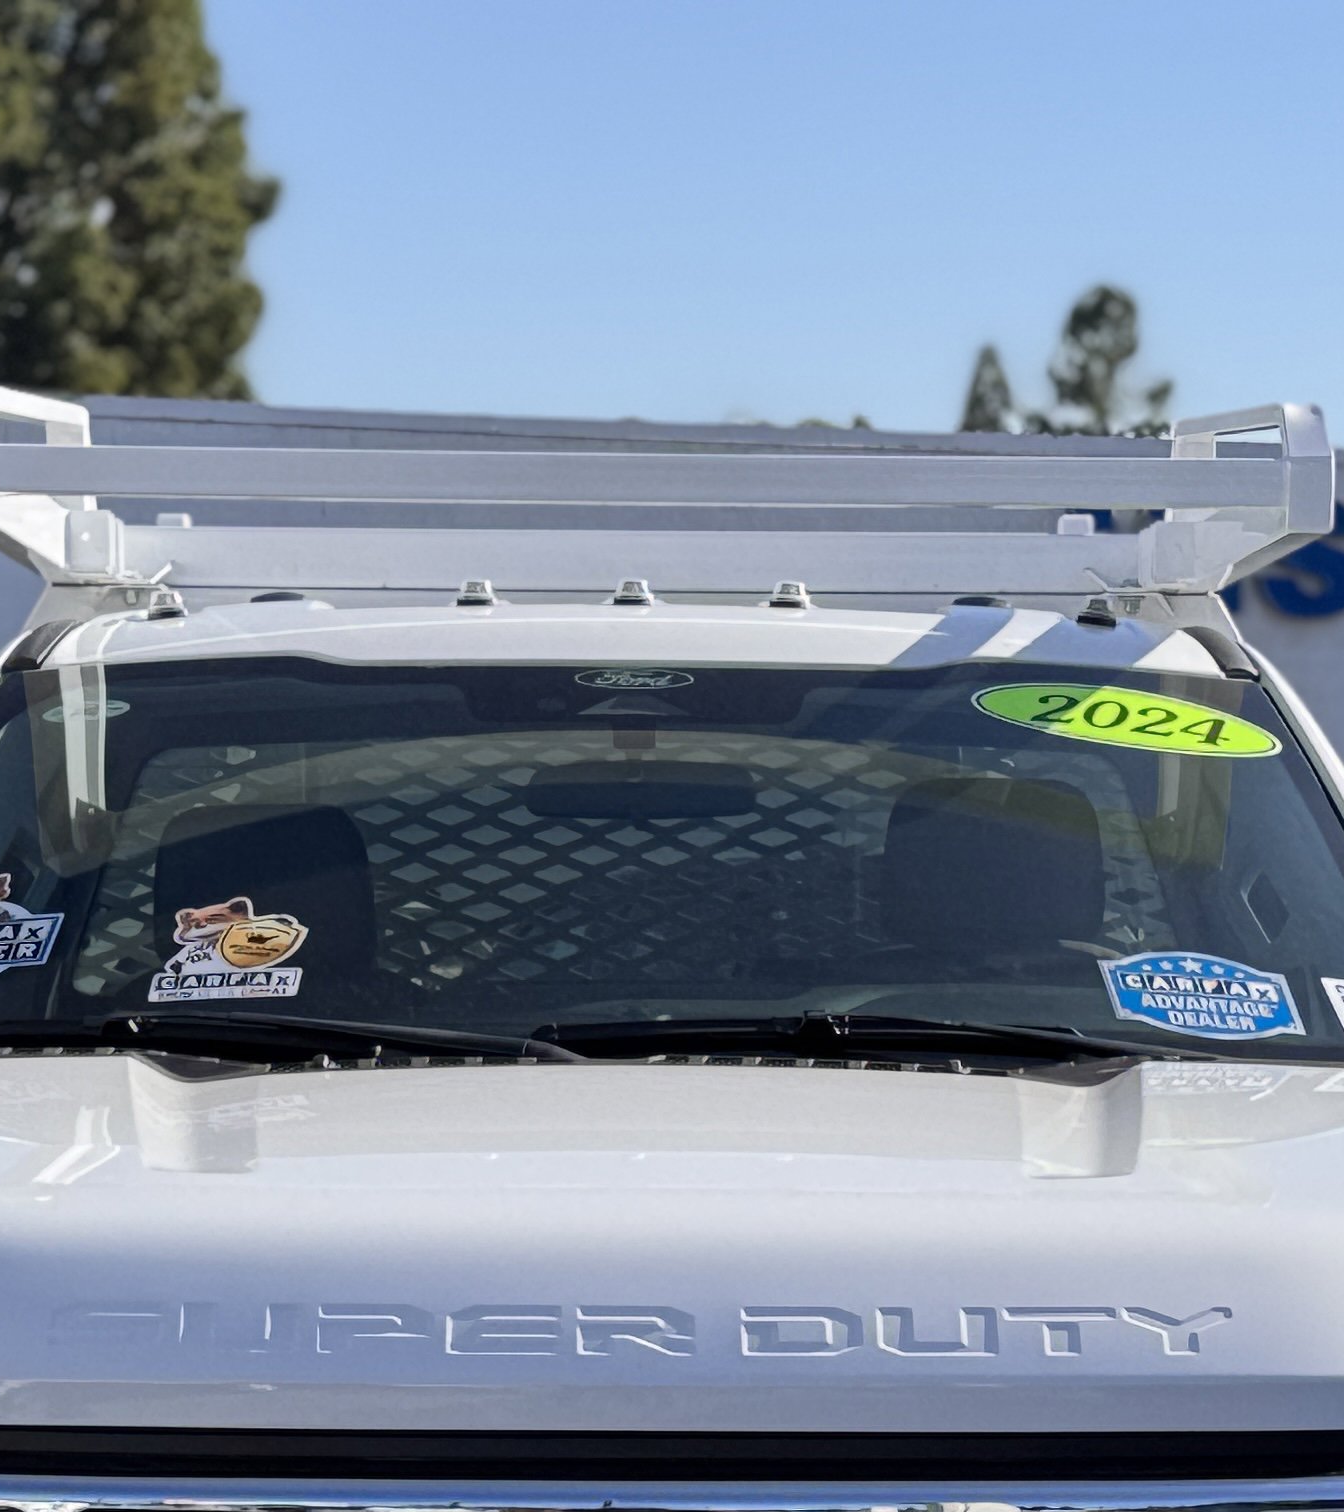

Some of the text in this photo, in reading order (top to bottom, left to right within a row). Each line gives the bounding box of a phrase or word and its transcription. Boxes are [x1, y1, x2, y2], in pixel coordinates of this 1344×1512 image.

[1030, 693, 1232, 746] 2024
[158, 972, 290, 990] CARFAX
[1124, 974, 1277, 1002] CARFAX
[1140, 994, 1277, 1019] ADVANTAGE
[1167, 1010, 1257, 1032] DEALER
[52, 1302, 1234, 1357] SUPER DUTY
